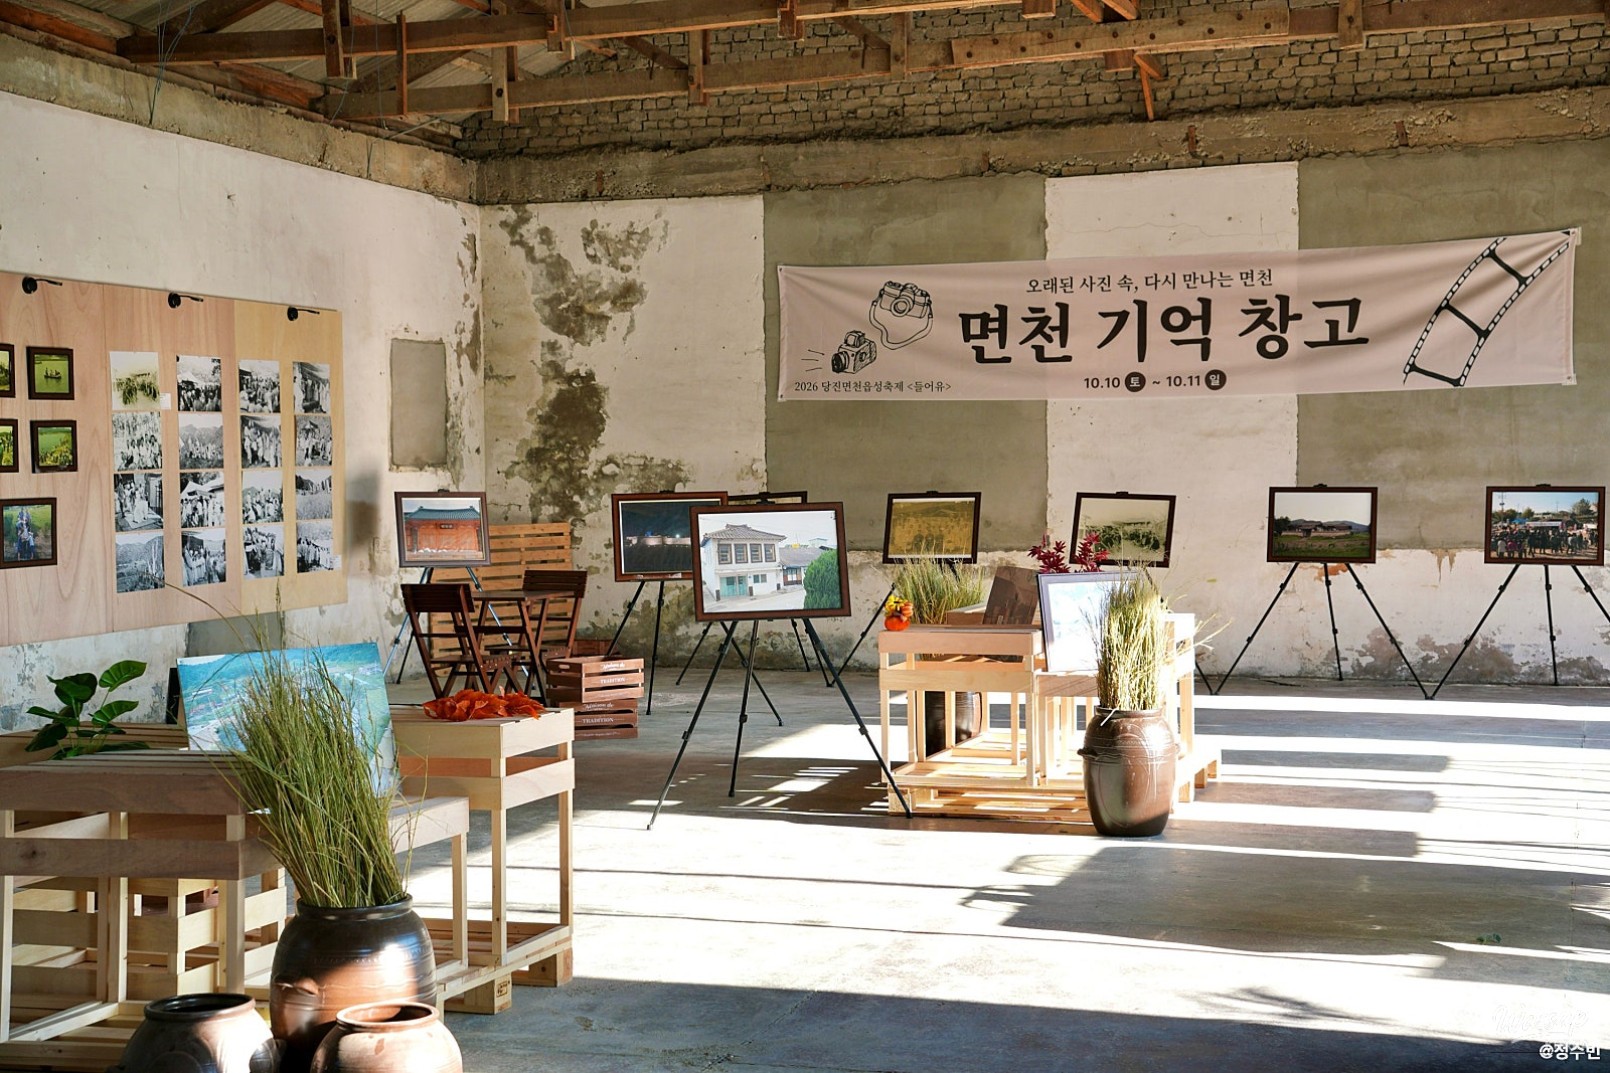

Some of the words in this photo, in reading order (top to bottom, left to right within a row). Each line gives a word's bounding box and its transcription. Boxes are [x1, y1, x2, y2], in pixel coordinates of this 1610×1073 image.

[1026, 276, 1074, 295] 오래된
[1079, 275, 1112, 293] 사진
[1117, 274, 1139, 292] 속,
[1144, 273, 1176, 291] 다시
[1182, 270, 1234, 290] 만나는
[1239, 268, 1273, 287] 면천
[958, 302, 1073, 364] 면천
[1096, 297, 1212, 363] 기억
[1238, 294, 1370, 360] 창고
[794, 381, 818, 392] 2026
[821, 380, 904, 393] 당진면천읍성축제
[907, 380, 952, 393] <들어유>
[1084, 377, 1121, 389] 10.10
[1166, 375, 1201, 387] 10.11
